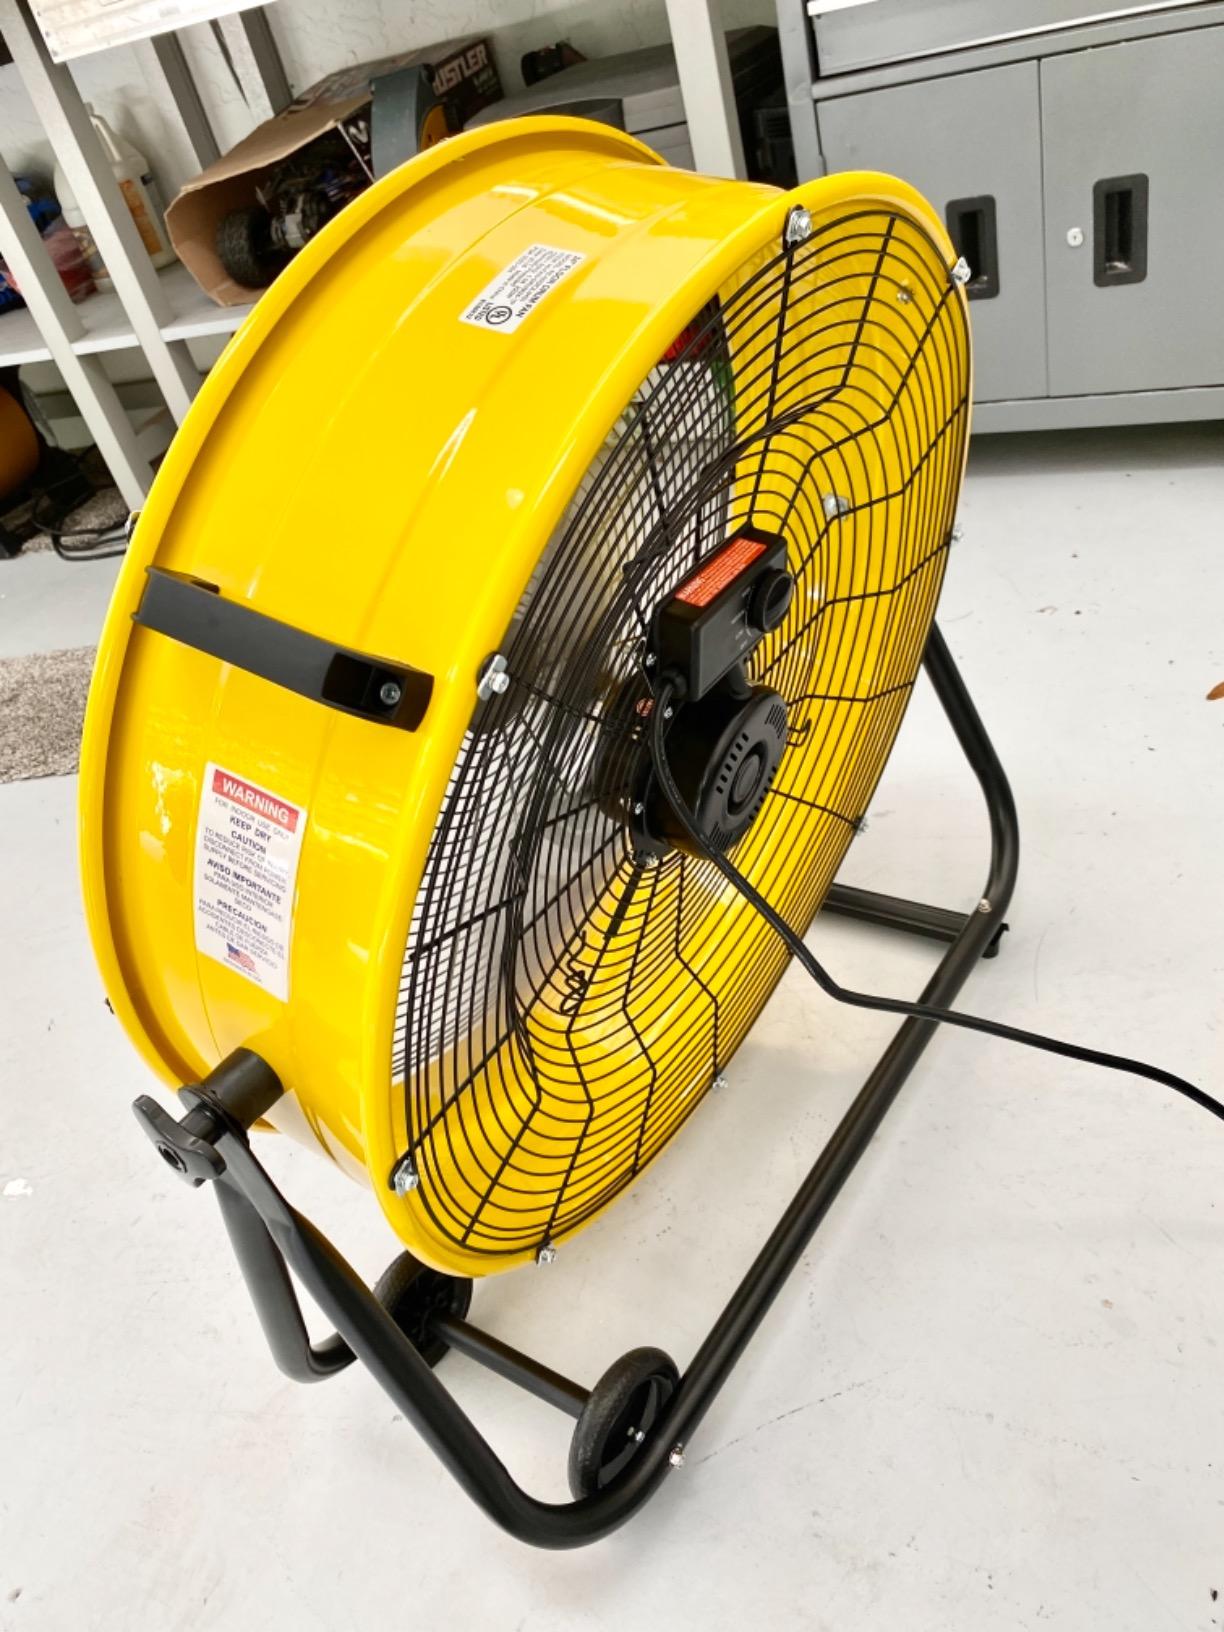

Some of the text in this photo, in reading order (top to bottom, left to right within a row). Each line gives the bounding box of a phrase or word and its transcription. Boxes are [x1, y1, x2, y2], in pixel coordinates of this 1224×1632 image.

[546, 264, 571, 284] FLOOR
[530, 285, 551, 303] DRUM
[515, 303, 533, 318] FAN
[214, 797, 230, 809] FOR
[230, 803, 256, 821] INDOOR
[257, 818, 272, 830] USE
[221, 777, 290, 824] WARNING
[205, 826, 215, 837] TO
[214, 832, 241, 849] REDUCE
[229, 816, 272, 843] KEEP DRY
[231, 830, 267, 855] CAUTION
[206, 858, 281, 905] AVISO IMPORTANTE
[217, 899, 268, 933] PRECAUCION
